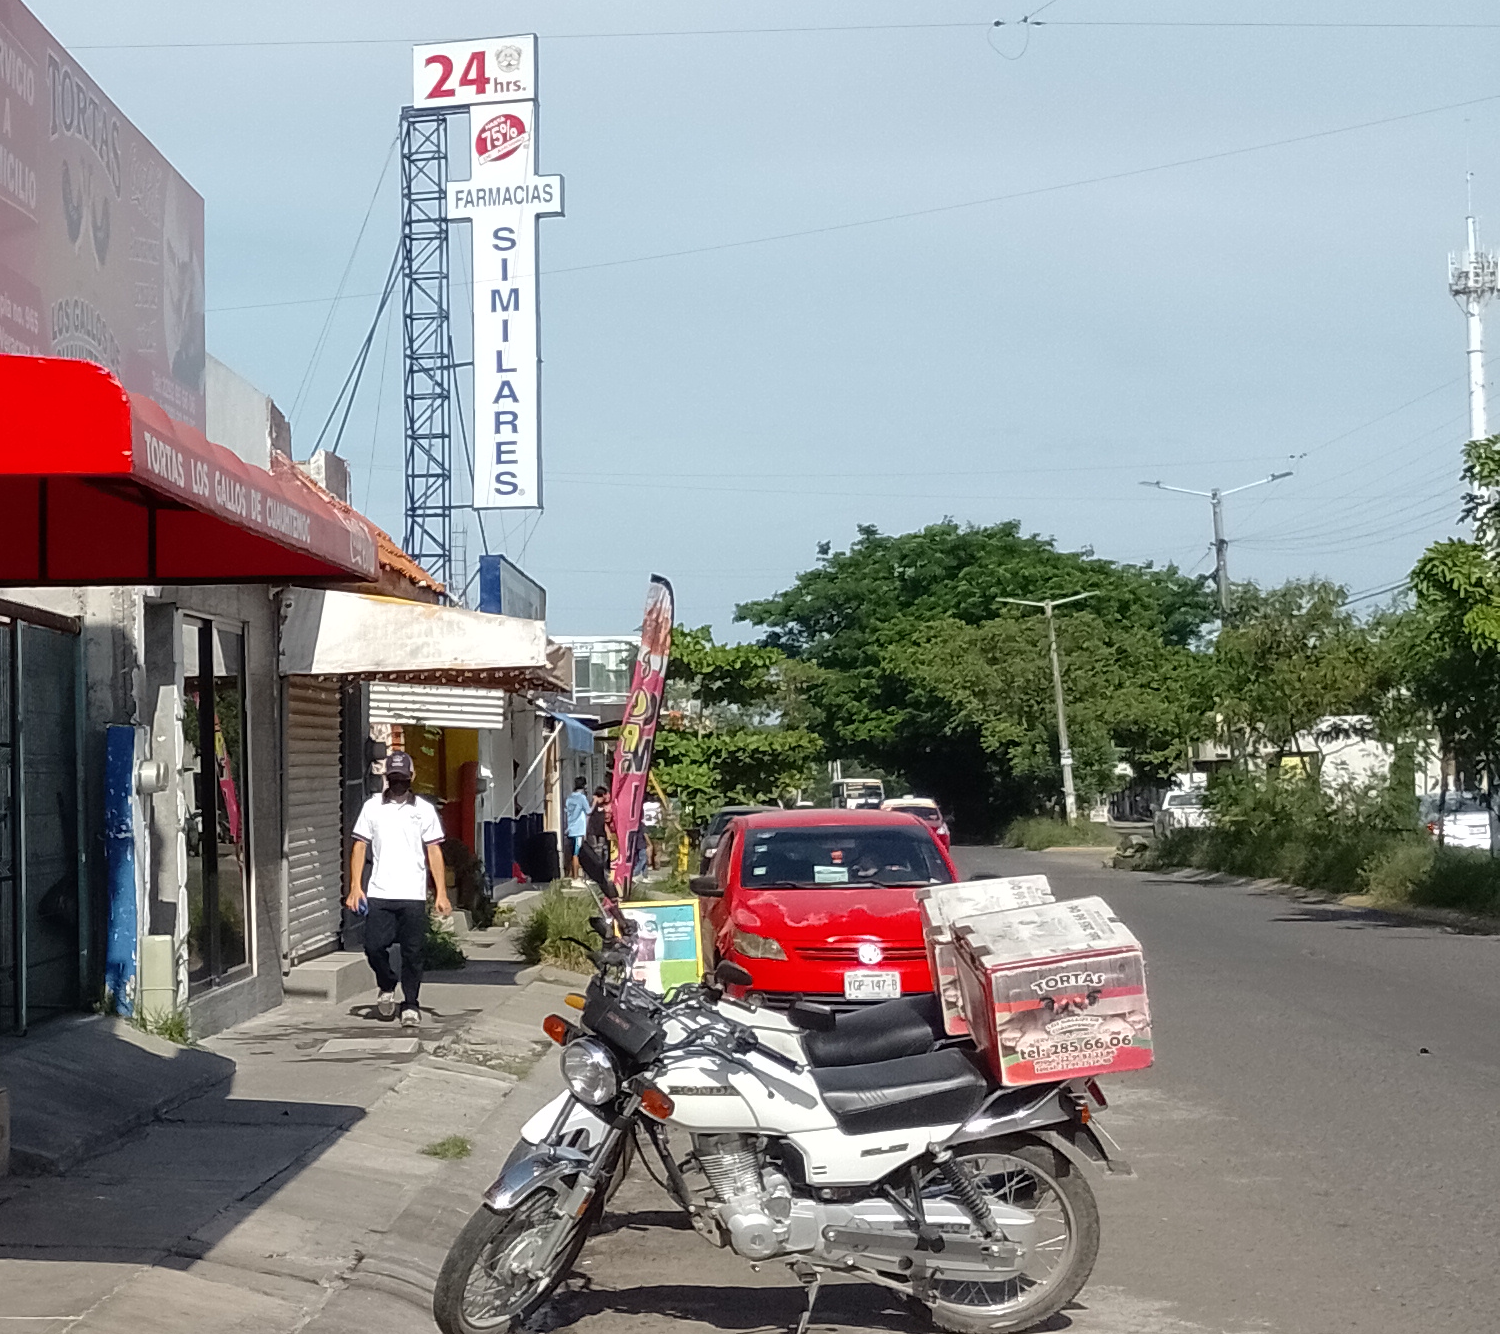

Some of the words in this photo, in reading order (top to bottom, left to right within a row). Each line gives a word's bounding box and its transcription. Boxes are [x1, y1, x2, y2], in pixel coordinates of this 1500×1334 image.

[424, 51, 491, 99] 24
[493, 77, 526, 93] hrs.
[2, 97, 13, 139] A
[46, 47, 122, 202] TORTAS
[481, 119, 518, 151] 75%
[454, 183, 554, 209] FARMACIAS
[51, 299, 71, 341] LOS
[71, 298, 107, 355] GALLOS
[490, 226, 521, 497] SIMILARES
[144, 431, 185, 488] TORTAS
[190, 458, 209, 497] LOS
[214, 470, 246, 518] GALLOS
[251, 489, 262, 522] DE
[1031, 972, 1105, 994] TORTAS
[1020, 1045, 1046, 1060] tel:
[1050, 1041, 1078, 1055] 285
[1083, 1037, 1104, 1051] 66
[1110, 1035, 1132, 1048] 06
